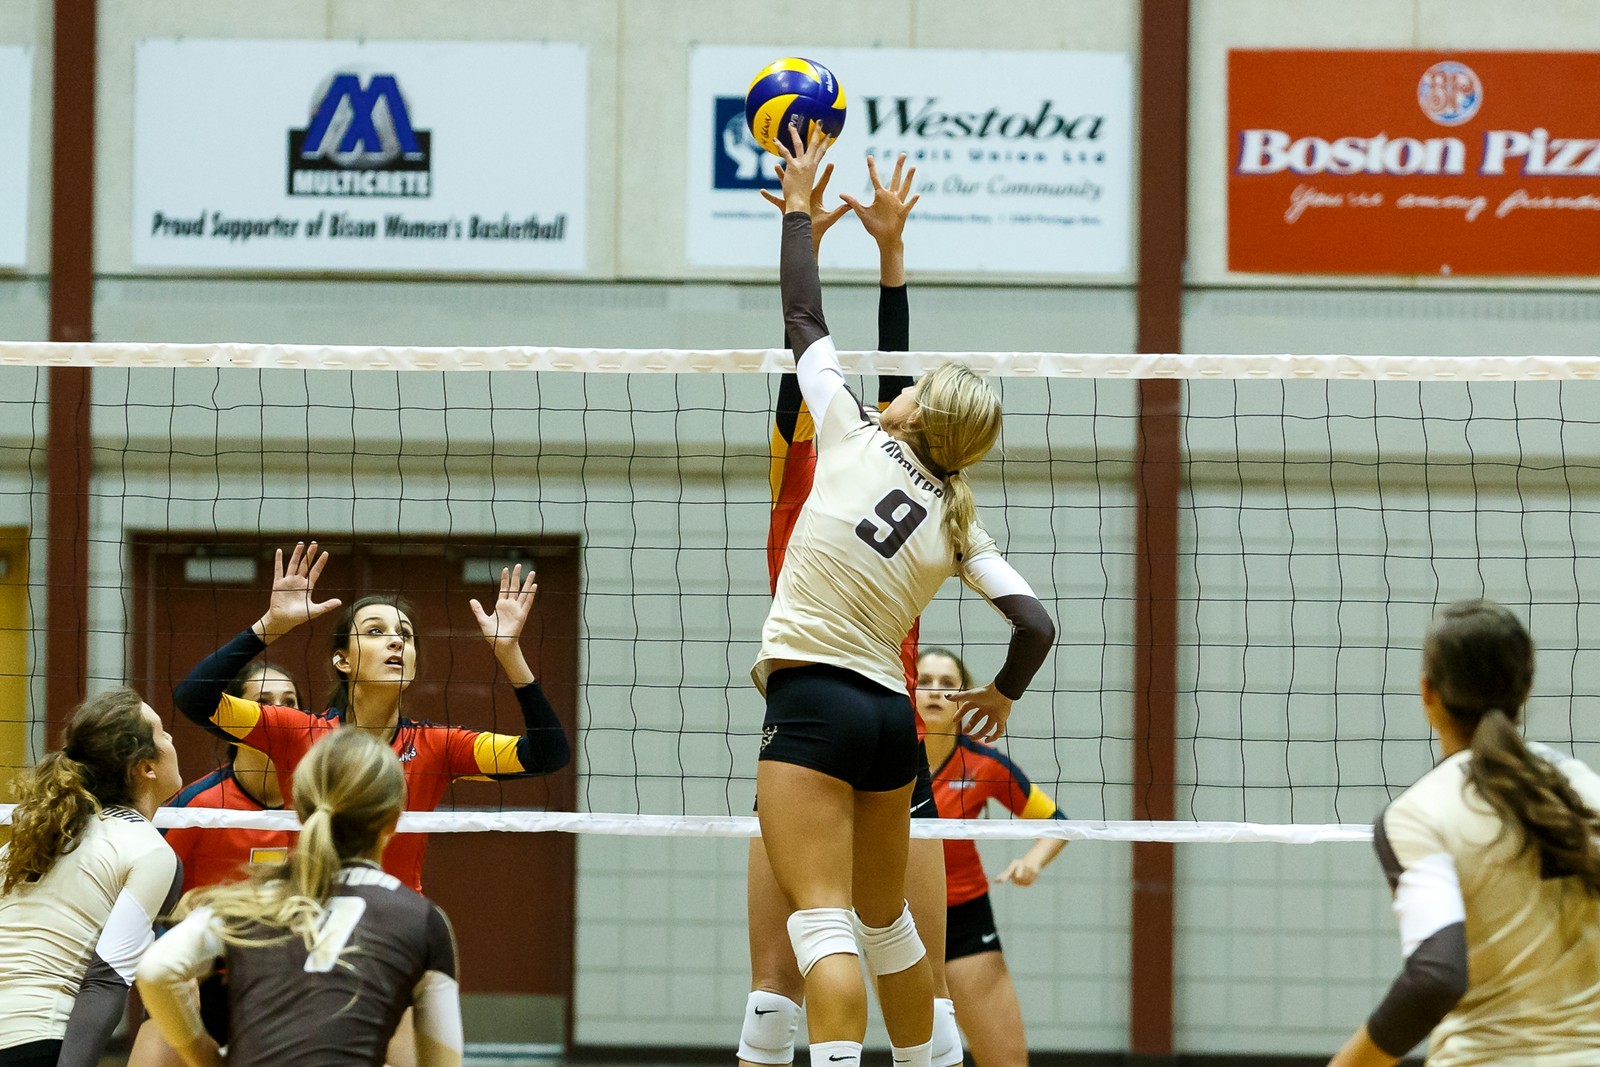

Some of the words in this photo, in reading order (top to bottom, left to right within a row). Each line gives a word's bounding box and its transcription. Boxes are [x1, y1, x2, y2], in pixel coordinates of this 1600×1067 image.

[863, 96, 1106, 140] Westoba
[968, 149, 1047, 163] Union
[1236, 129, 1467, 175] Boston
[292, 169, 429, 194] MULTICRETE
[943, 174, 979, 196] Our
[986, 174, 1103, 202] Community
[152, 210, 207, 237] Proud
[211, 210, 299, 244] Supporter
[304, 209, 325, 237] of
[328, 212, 375, 239] Bison
[384, 212, 463, 239] Women's
[468, 212, 567, 241] Basketball
[855, 488, 928, 559] 9
